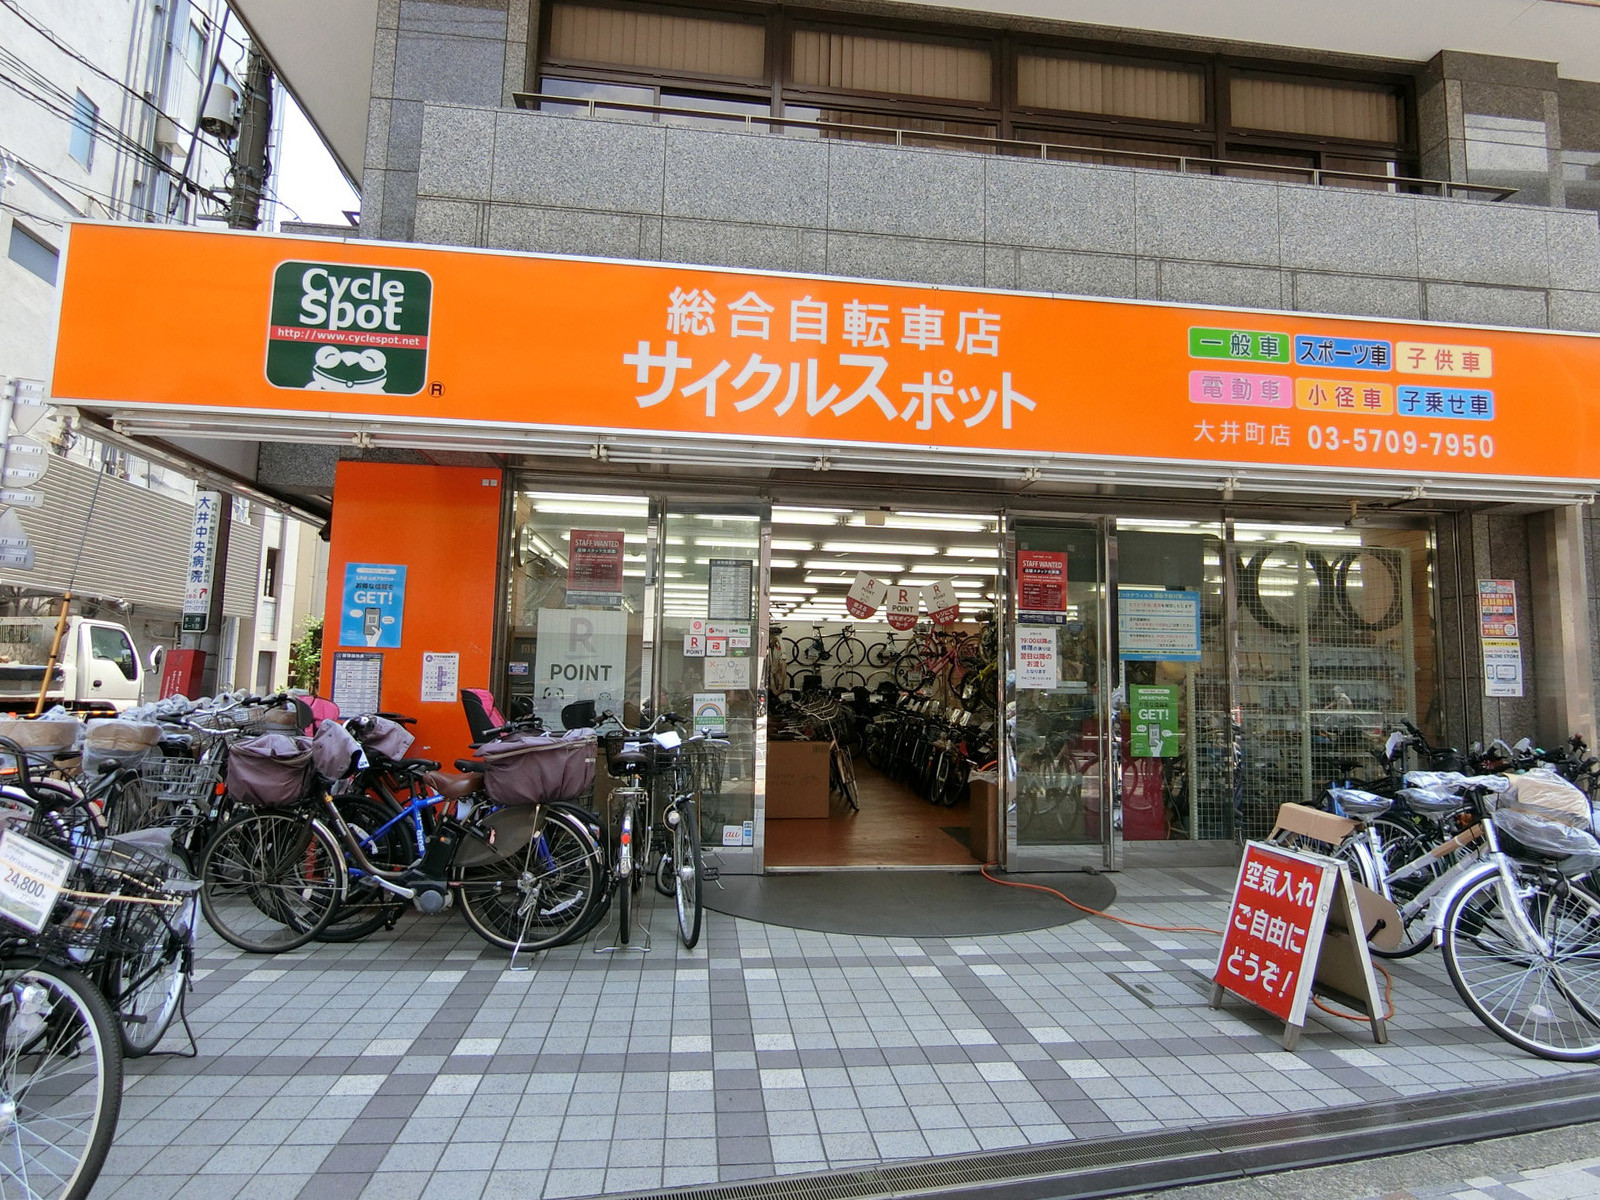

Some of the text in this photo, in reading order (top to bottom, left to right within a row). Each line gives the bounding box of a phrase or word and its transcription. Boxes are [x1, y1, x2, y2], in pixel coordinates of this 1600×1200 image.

[302, 268, 405, 301] Cycle
[299, 295, 402, 331] Spot
[666, 286, 1001, 357] 総合自転車店
[277, 328, 420, 346] http://www.cyclespot.net
[1200, 332, 1280, 359] 一般車
[1300, 340, 1388, 367] スポーツ車
[1407, 347, 1481, 373] 子供車
[623, 340, 1037, 431] サイクルスポット
[1201, 375, 1281, 402] 電動車
[1307, 385, 1382, 410] 小径車
[1402, 391, 1489, 416] 子乗せ車
[1193, 419, 1494, 459] 大井町店 03-5709-7950
[190, 496, 211, 583] 大井中央病院
[354, 590, 393, 605] GET!
[867, 579, 875, 589] R
[899, 589, 908, 602] R
[933, 585, 941, 594] R
[892, 605, 914, 613] POINT
[569, 617, 597, 653] R
[691, 637, 699, 647] R
[550, 663, 613, 681] POINT
[1138, 708, 1169, 720] GET!
[1243, 861, 1315, 908] 空気入れ
[1234, 902, 1305, 954] ご自由に
[1226, 946, 1294, 998] どうぞ!
